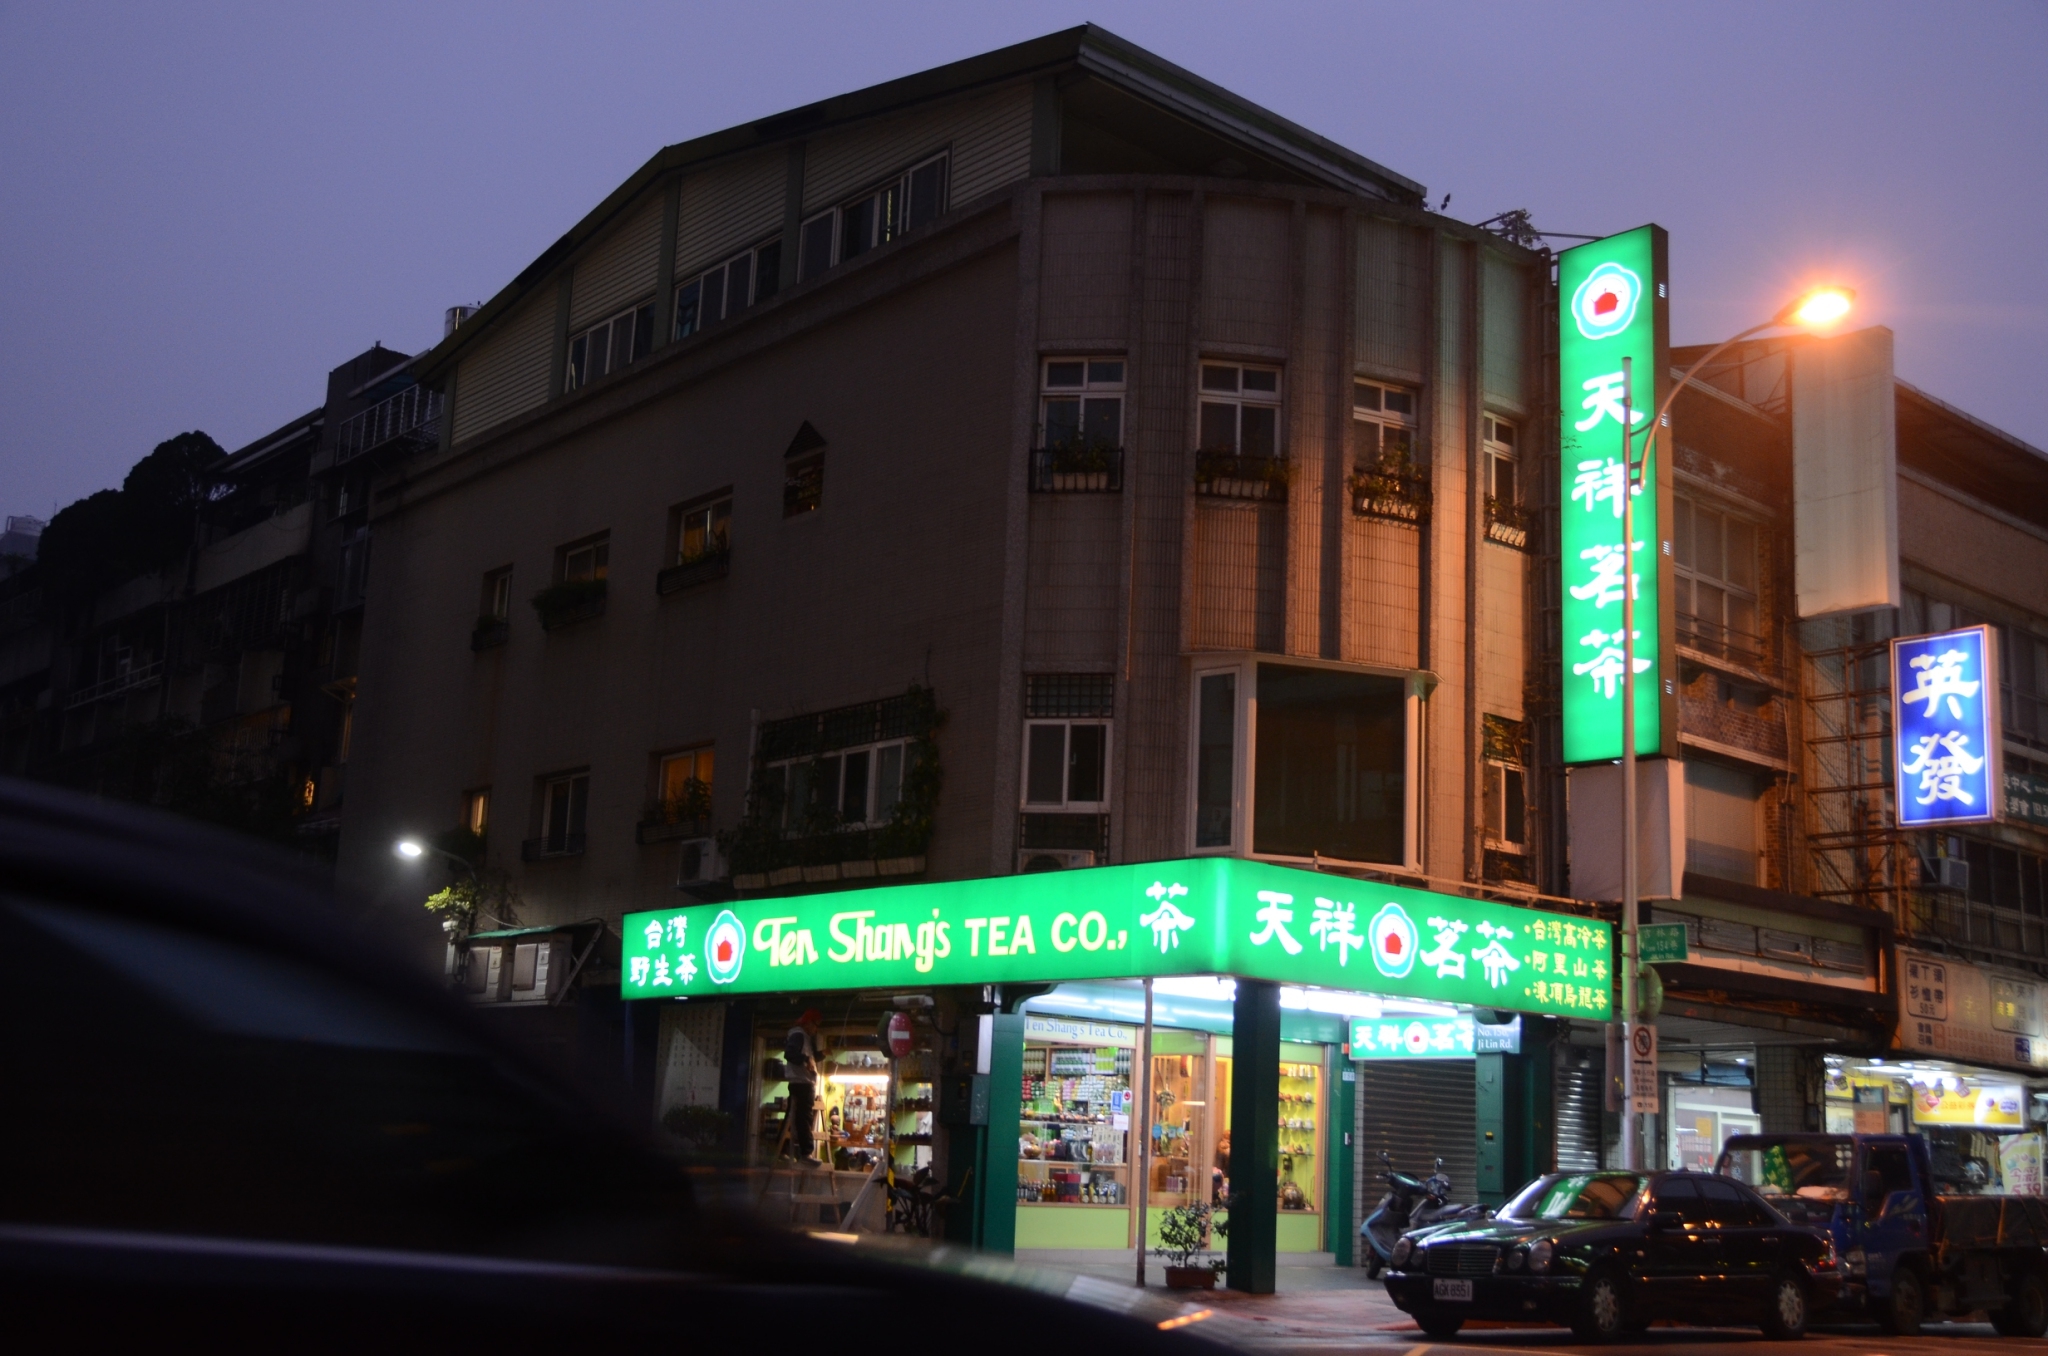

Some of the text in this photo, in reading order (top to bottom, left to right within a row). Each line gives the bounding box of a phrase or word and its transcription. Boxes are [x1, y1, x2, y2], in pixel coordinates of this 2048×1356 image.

[1570, 371, 1652, 700] 天祥茗茶
[1902, 648, 1983, 806] 英發
[644, 914, 688, 950] 台灣
[752, 908, 1128, 973] Ten Shang's TEA CO.,
[1139, 880, 1196, 954] 茶
[1249, 890, 1521, 989] 天祥 茗茶
[1532, 918, 1607, 951] 台灣高冷茶
[629, 953, 698, 987] 野生茶
[1532, 950, 1608, 981] 阿里山茶
[1499, 1038, 1513, 1049] Rd.
